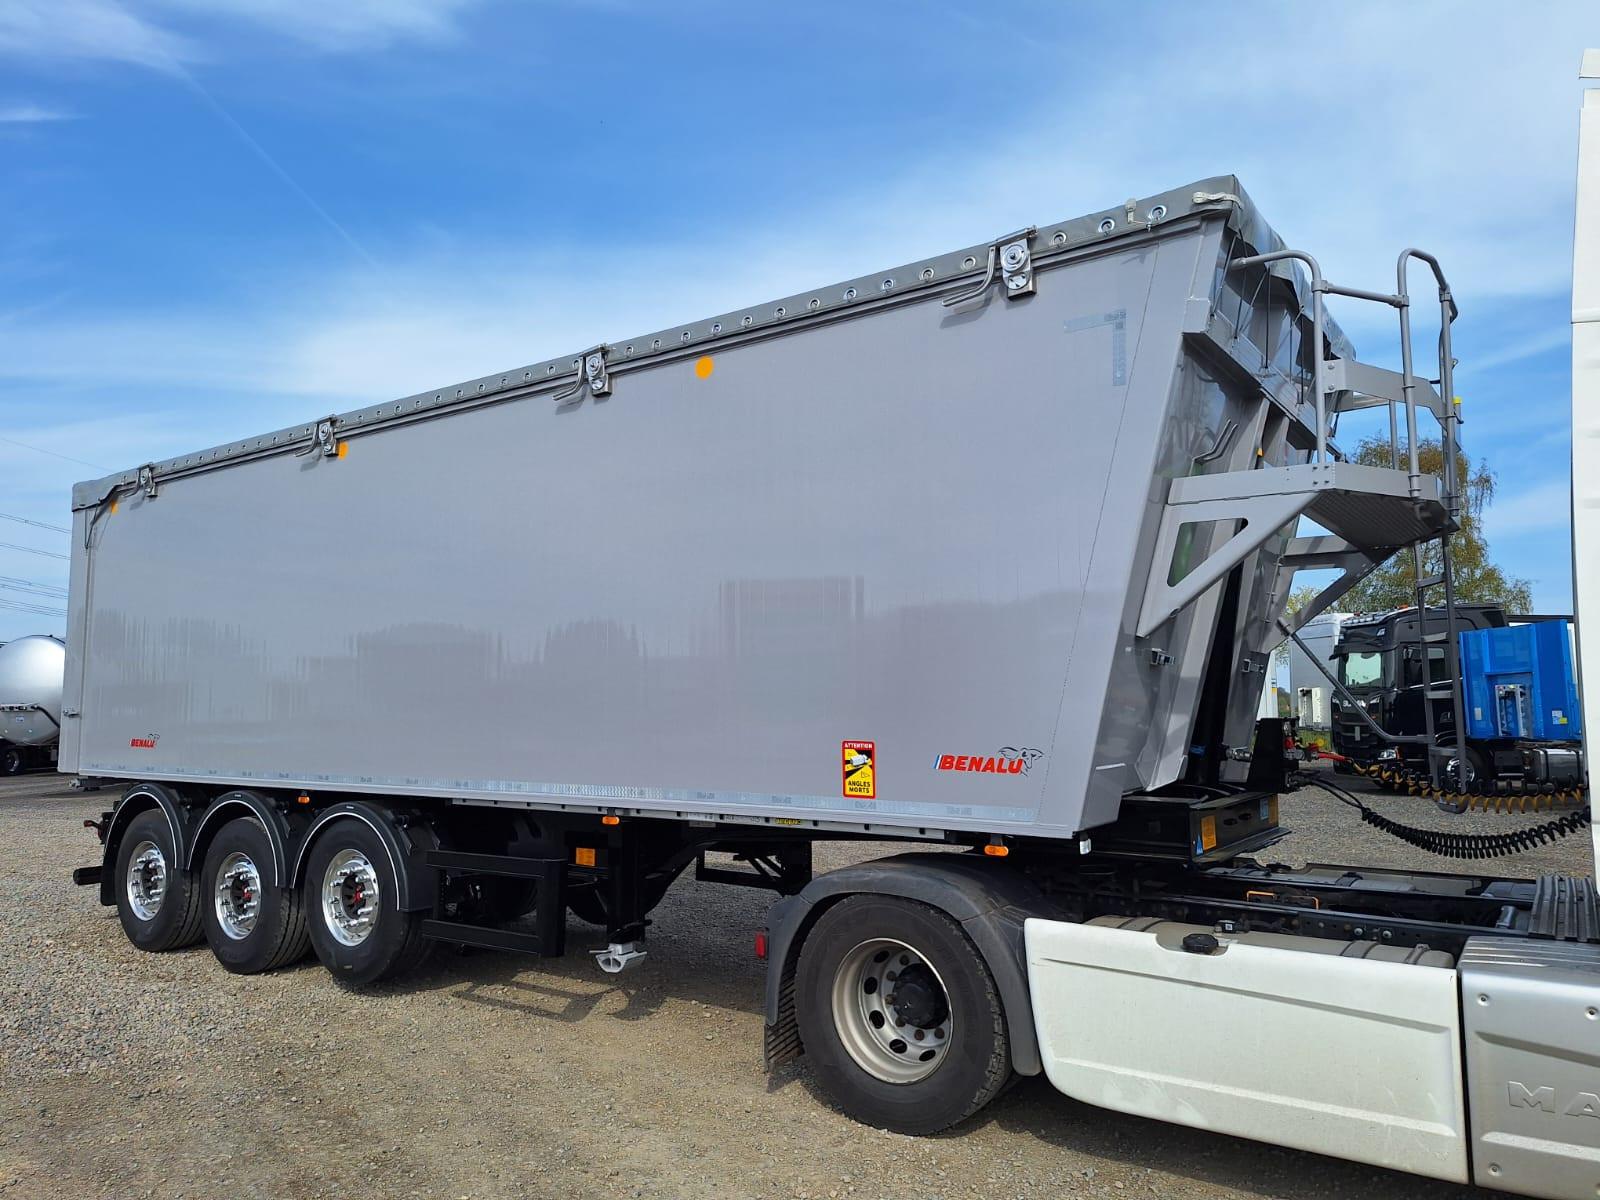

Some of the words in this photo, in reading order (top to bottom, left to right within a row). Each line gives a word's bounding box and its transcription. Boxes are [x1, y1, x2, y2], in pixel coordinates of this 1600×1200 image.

[938, 754, 1024, 774] BENALU
[848, 780, 871, 788] ANGLES
[848, 786, 870, 794] MORTS
